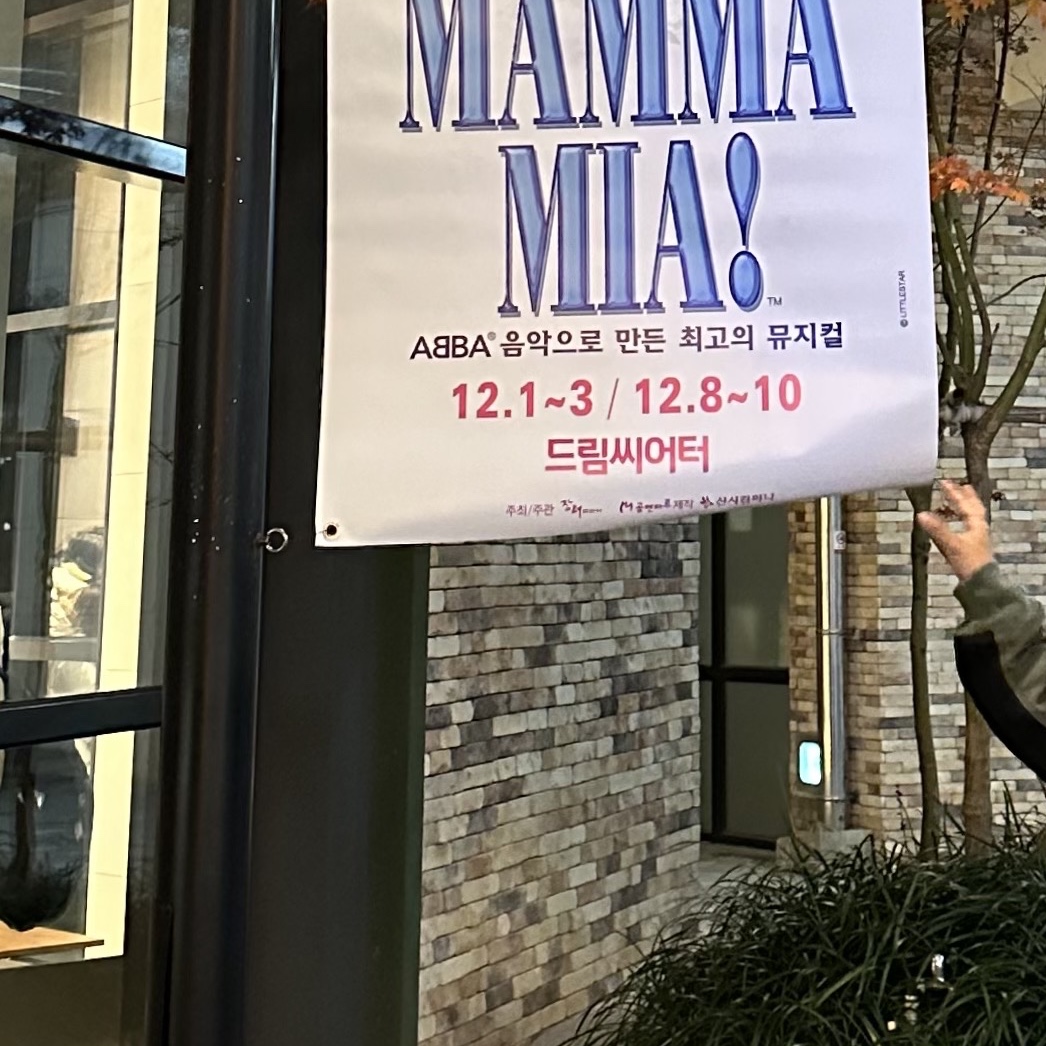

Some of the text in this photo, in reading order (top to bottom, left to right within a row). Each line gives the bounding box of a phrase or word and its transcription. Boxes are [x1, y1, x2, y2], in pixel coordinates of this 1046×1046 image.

[399, 0, 856, 131] MAMMA
[497, 132, 763, 317] MIA!
[500, 330, 604, 357] 음악으로
[615, 327, 667, 355] 만든
[679, 325, 754, 352] 최고의
[767, 322, 843, 350] 뮤지컬
[452, 379, 594, 419] 12.1~3
[635, 374, 802, 415] 12.8~10
[545, 435, 710, 476] 드림씨어터
